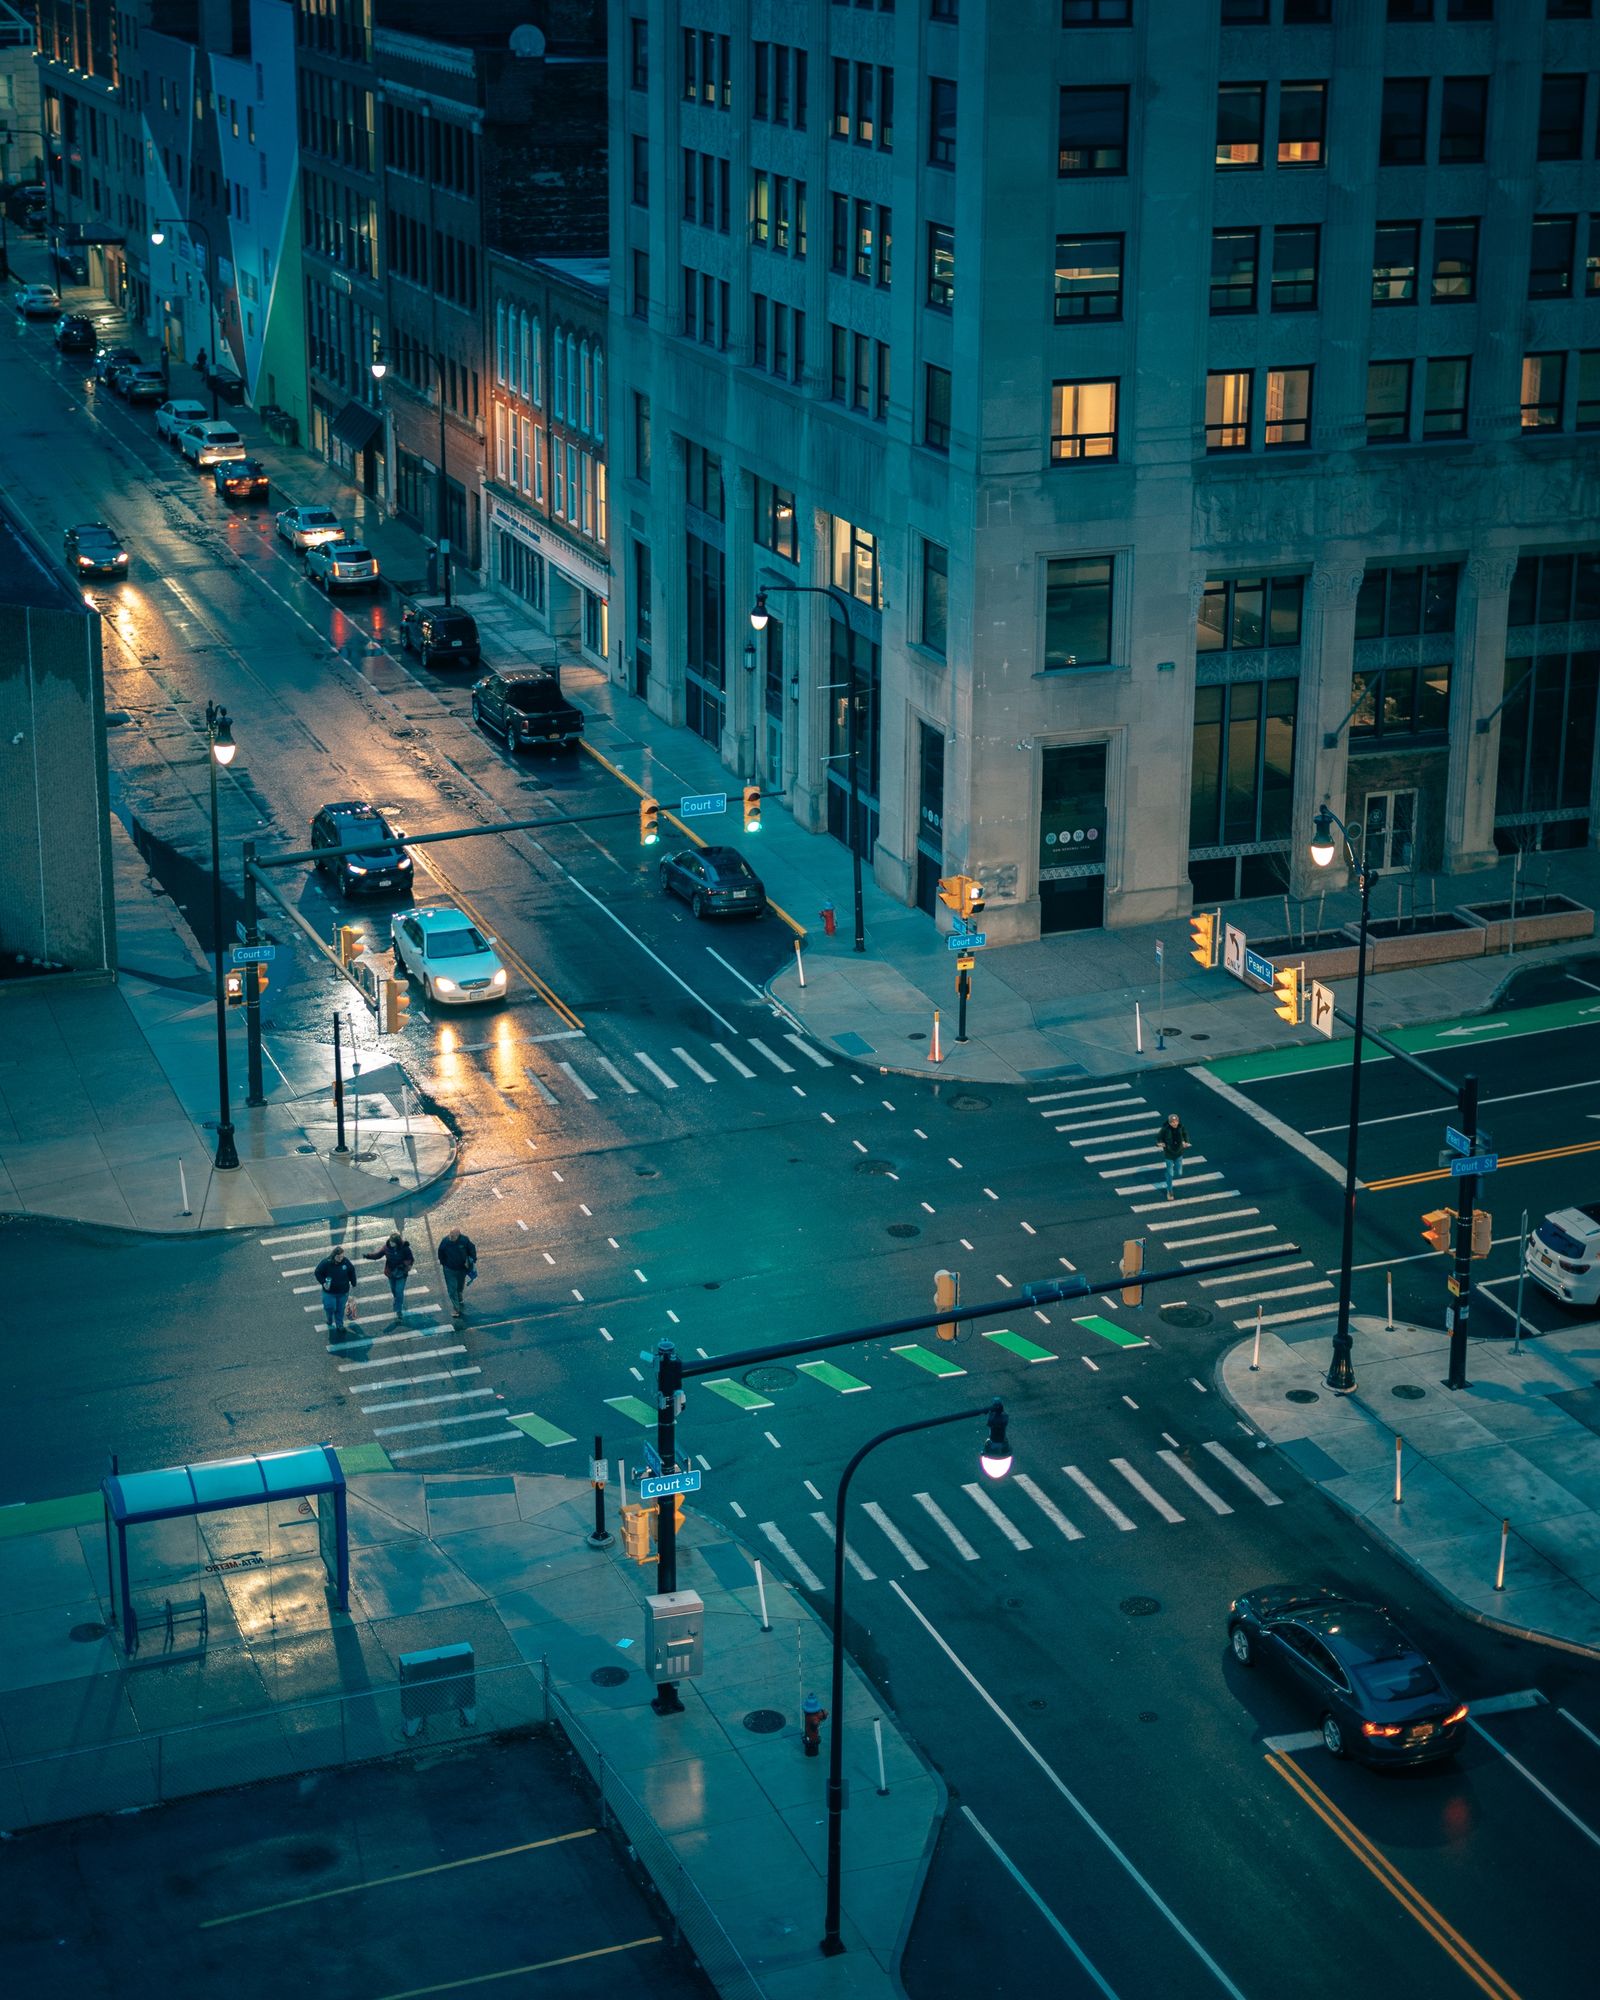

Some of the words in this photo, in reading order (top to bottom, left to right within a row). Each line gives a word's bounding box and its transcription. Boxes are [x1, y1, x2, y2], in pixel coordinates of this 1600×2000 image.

[683, 800, 711, 812] Court
[715, 799, 724, 808] St
[952, 937, 970, 947] Court
[975, 935, 983, 944] St
[237, 949, 260, 959] Court
[263, 949, 271, 957] St
[1226, 956, 1241, 971] ONLY
[1248, 955, 1265, 977] Pearl
[1265, 968, 1271, 979] St
[1455, 1160, 1478, 1172] Court
[1484, 1158, 1493, 1169] St
[647, 1478, 680, 1493] Court
[685, 1477, 694, 1486] St
